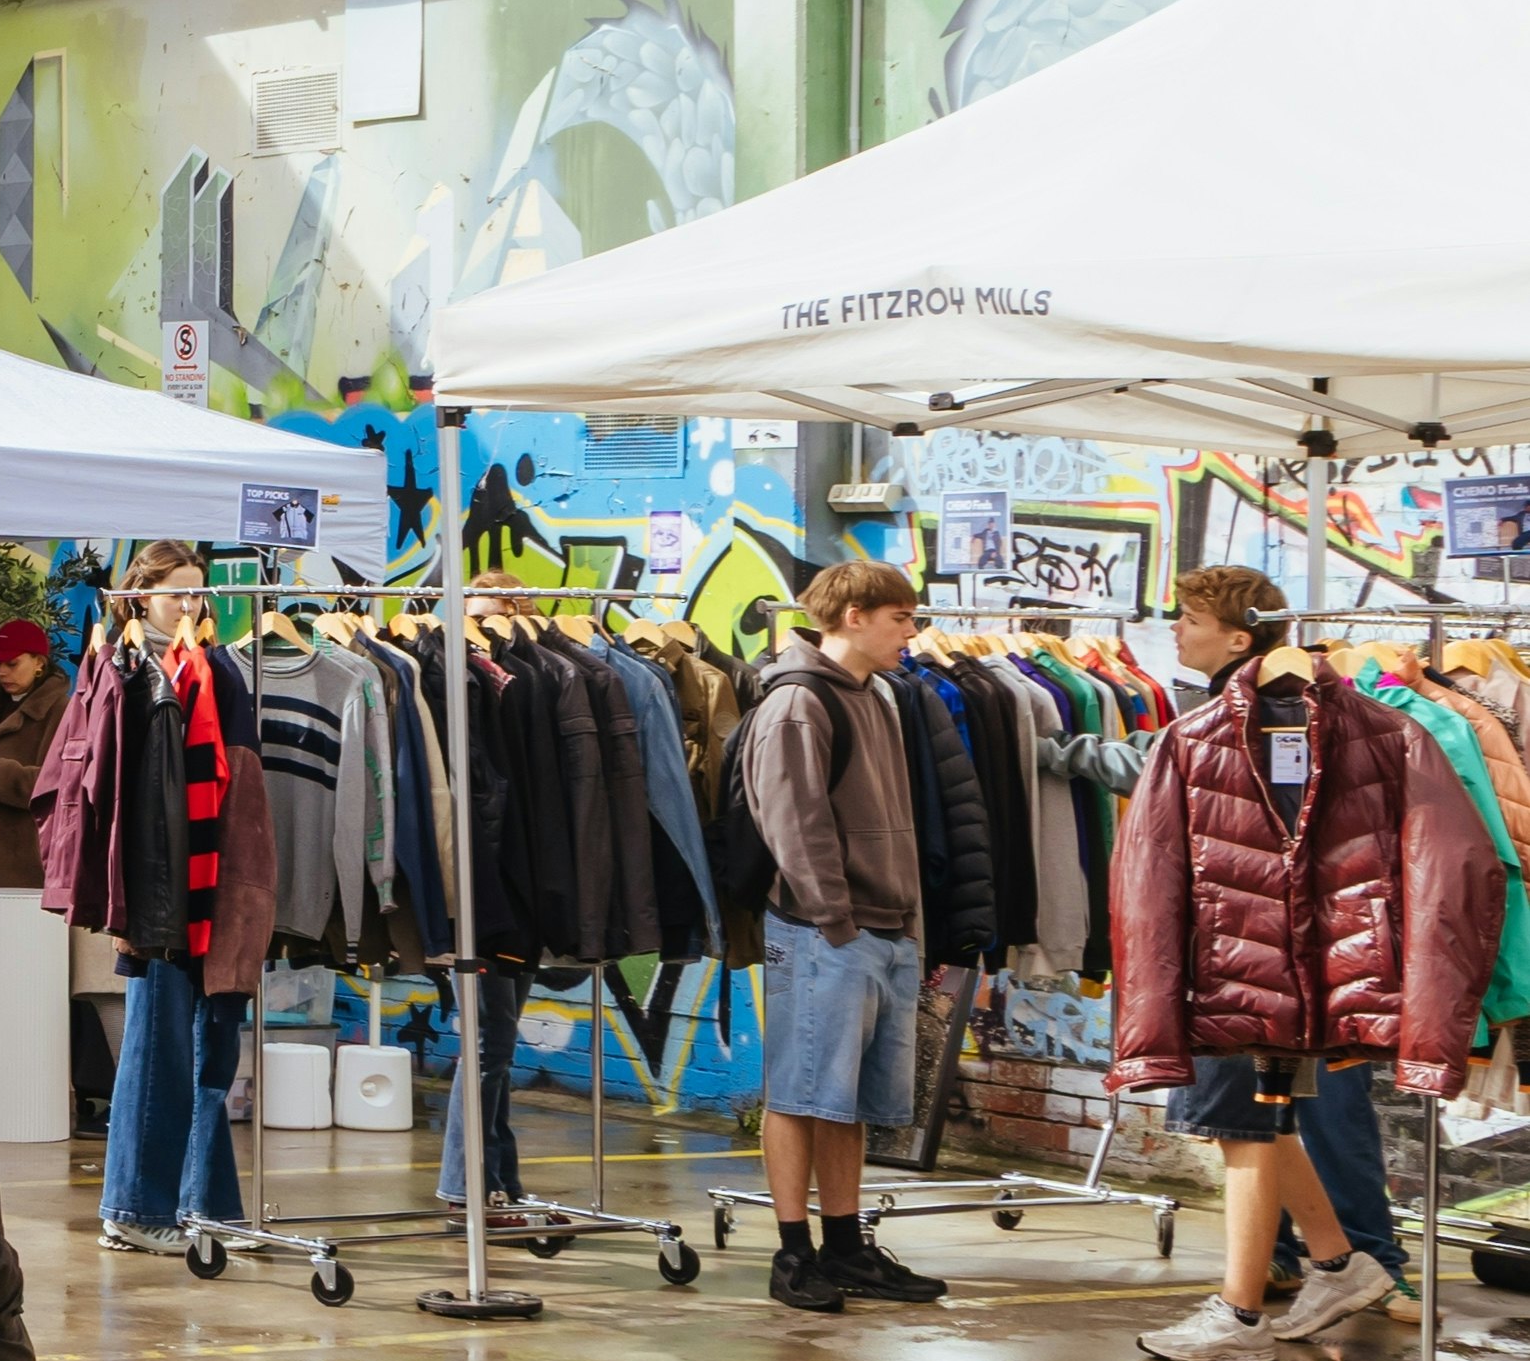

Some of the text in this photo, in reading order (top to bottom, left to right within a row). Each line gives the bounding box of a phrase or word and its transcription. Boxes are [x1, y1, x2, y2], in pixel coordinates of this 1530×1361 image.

[782, 287, 1053, 330] THE FITZROY MILLS
[165, 374, 175, 382] NO
[246, 489, 290, 501] TOP PICKS
[1452, 483, 1529, 497] CHEMO Finds
